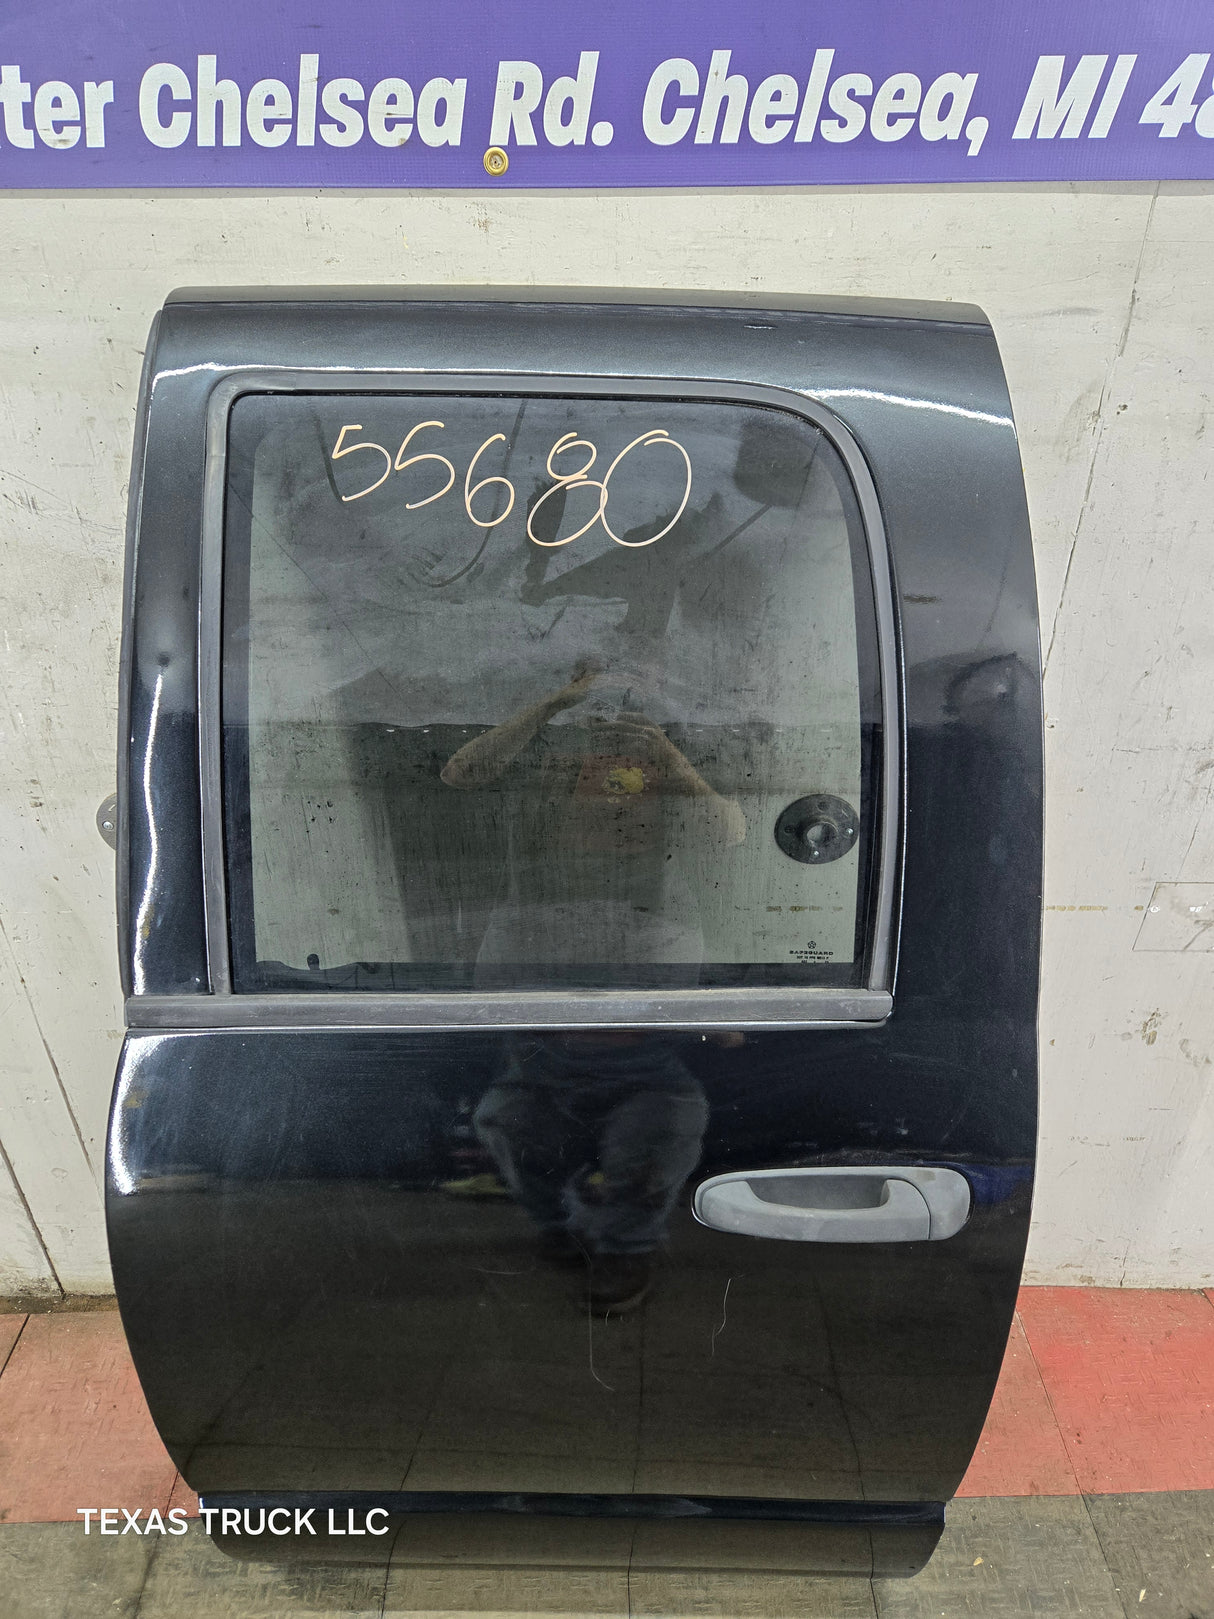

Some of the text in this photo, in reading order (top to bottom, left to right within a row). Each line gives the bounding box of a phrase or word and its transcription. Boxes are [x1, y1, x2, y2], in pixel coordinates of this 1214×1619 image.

[139, 54, 467, 149] Chelsea
[489, 51, 614, 147] Rd.
[643, 49, 989, 156] Chelsea,
[1012, 54, 1138, 139] MI
[332, 420, 692, 547] 55680
